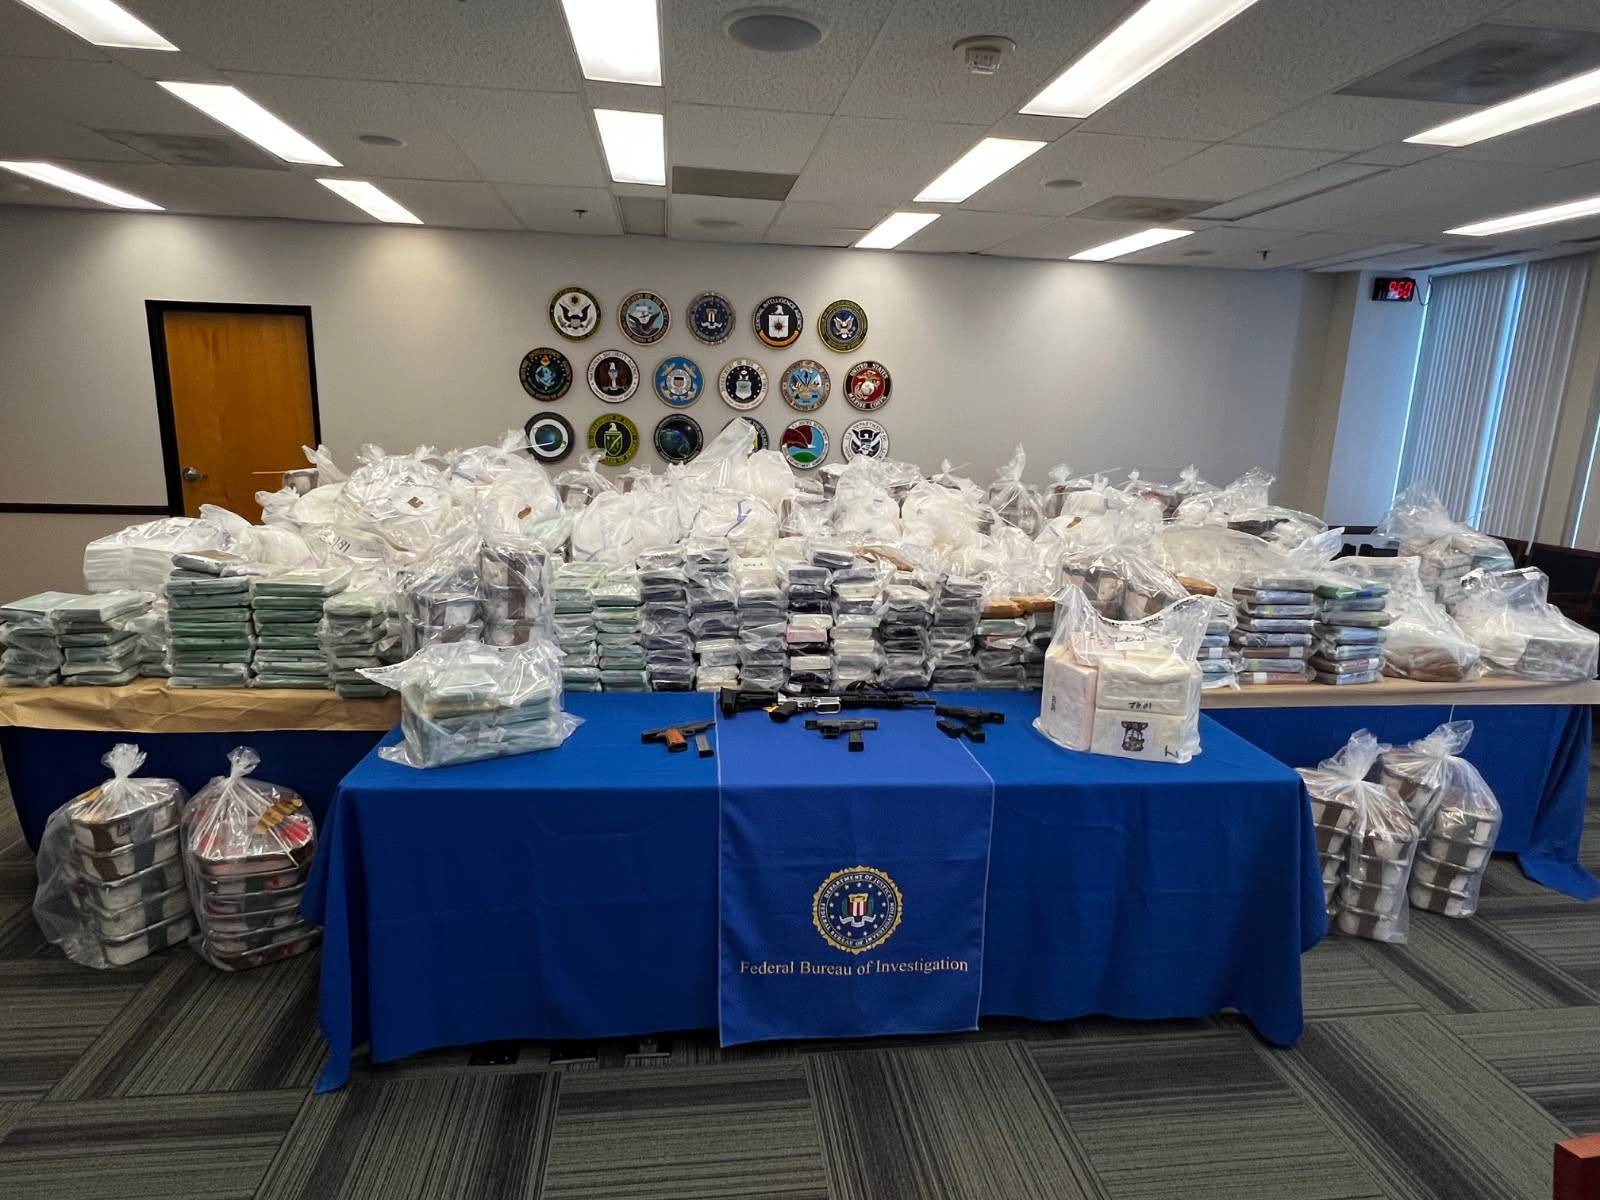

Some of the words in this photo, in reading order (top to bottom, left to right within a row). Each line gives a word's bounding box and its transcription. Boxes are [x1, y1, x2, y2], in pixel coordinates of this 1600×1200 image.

[850, 363, 868, 377] UNITED
[872, 363, 888, 379] STATES
[848, 393, 866, 409] MARINE
[870, 396, 887, 409] CORPS
[824, 875, 863, 898] DEPARTMENT
[873, 877, 893, 898] JUSTICE
[820, 903, 831, 931] FEDERAL
[830, 930, 853, 946] BUREAU
[865, 902, 894, 944] INVESTIGATION
[740, 960, 794, 974] Federal
[800, 961, 851, 975] Bureau
[857, 960, 874, 975] of
[876, 957, 968, 974] Investigation
